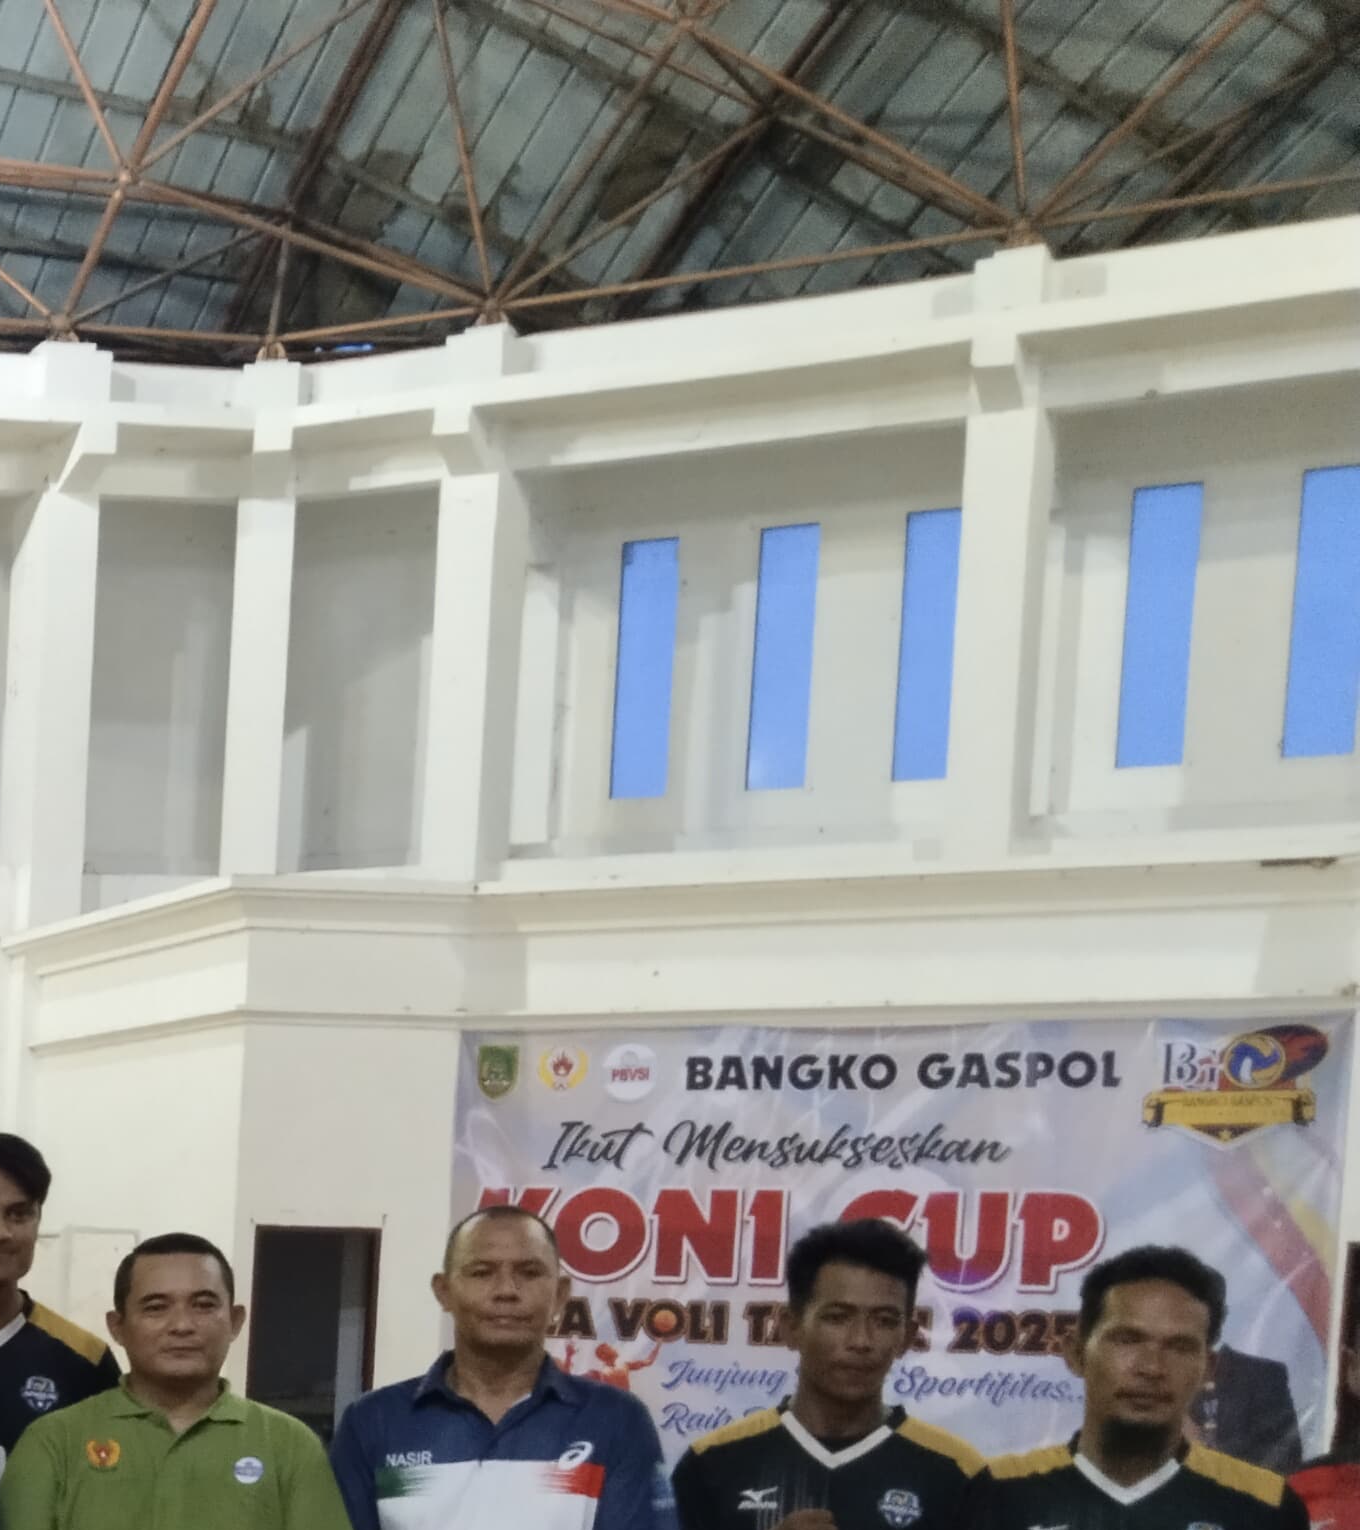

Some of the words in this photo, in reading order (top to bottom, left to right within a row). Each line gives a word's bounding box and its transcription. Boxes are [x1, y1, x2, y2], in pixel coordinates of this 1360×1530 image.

[611, 1067, 650, 1082] PBVSI
[685, 1053, 898, 1090] BANGKO
[917, 1050, 1122, 1089] GASPOL
[541, 1120, 655, 1170] Ikut
[662, 1118, 1013, 1171] Mensukseskan
[608, 1297, 730, 1345] VOLI
[661, 1358, 788, 1394] Junjung
[386, 1451, 432, 1467] NASIR
